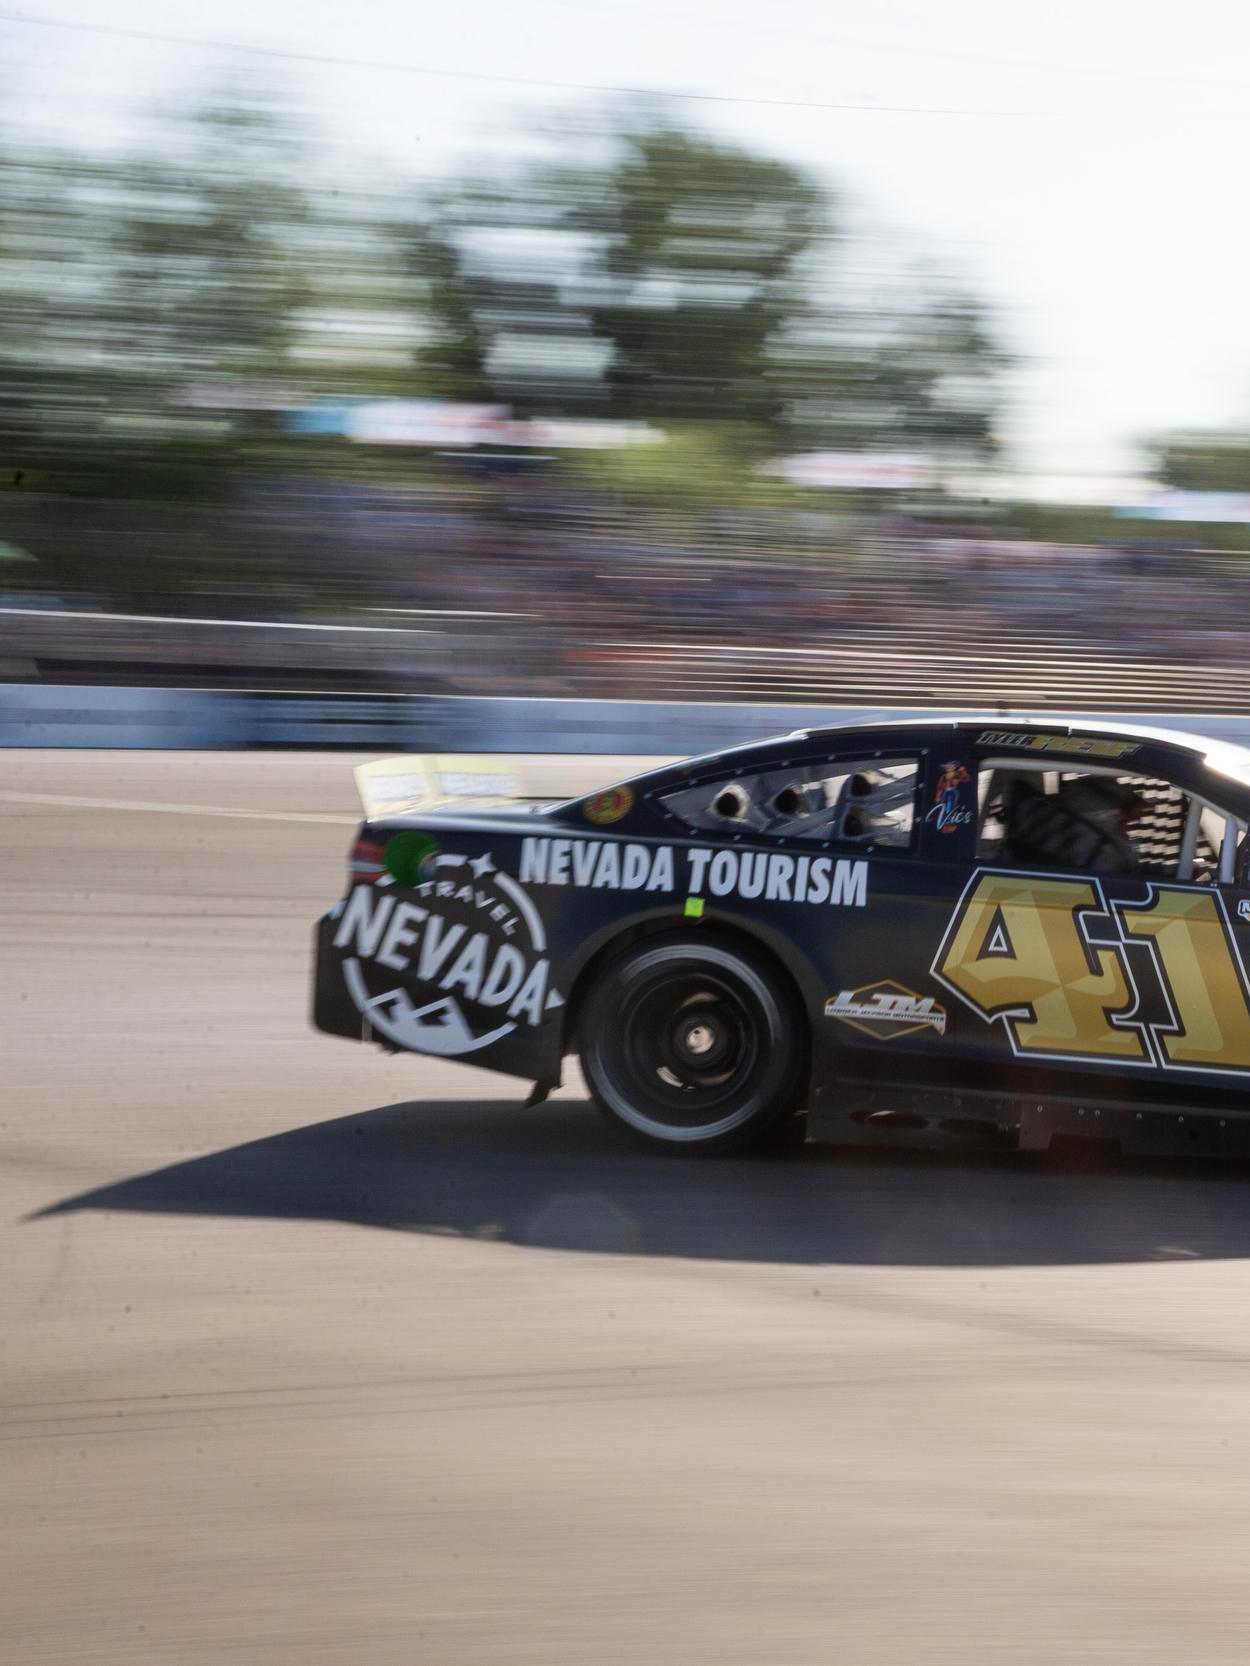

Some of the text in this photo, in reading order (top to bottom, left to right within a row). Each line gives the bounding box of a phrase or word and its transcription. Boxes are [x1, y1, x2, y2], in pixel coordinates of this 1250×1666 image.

[519, 837, 869, 907] NEVADA TOURISM
[414, 880, 519, 936] TRAVEL
[332, 884, 551, 1027] NEVADA
